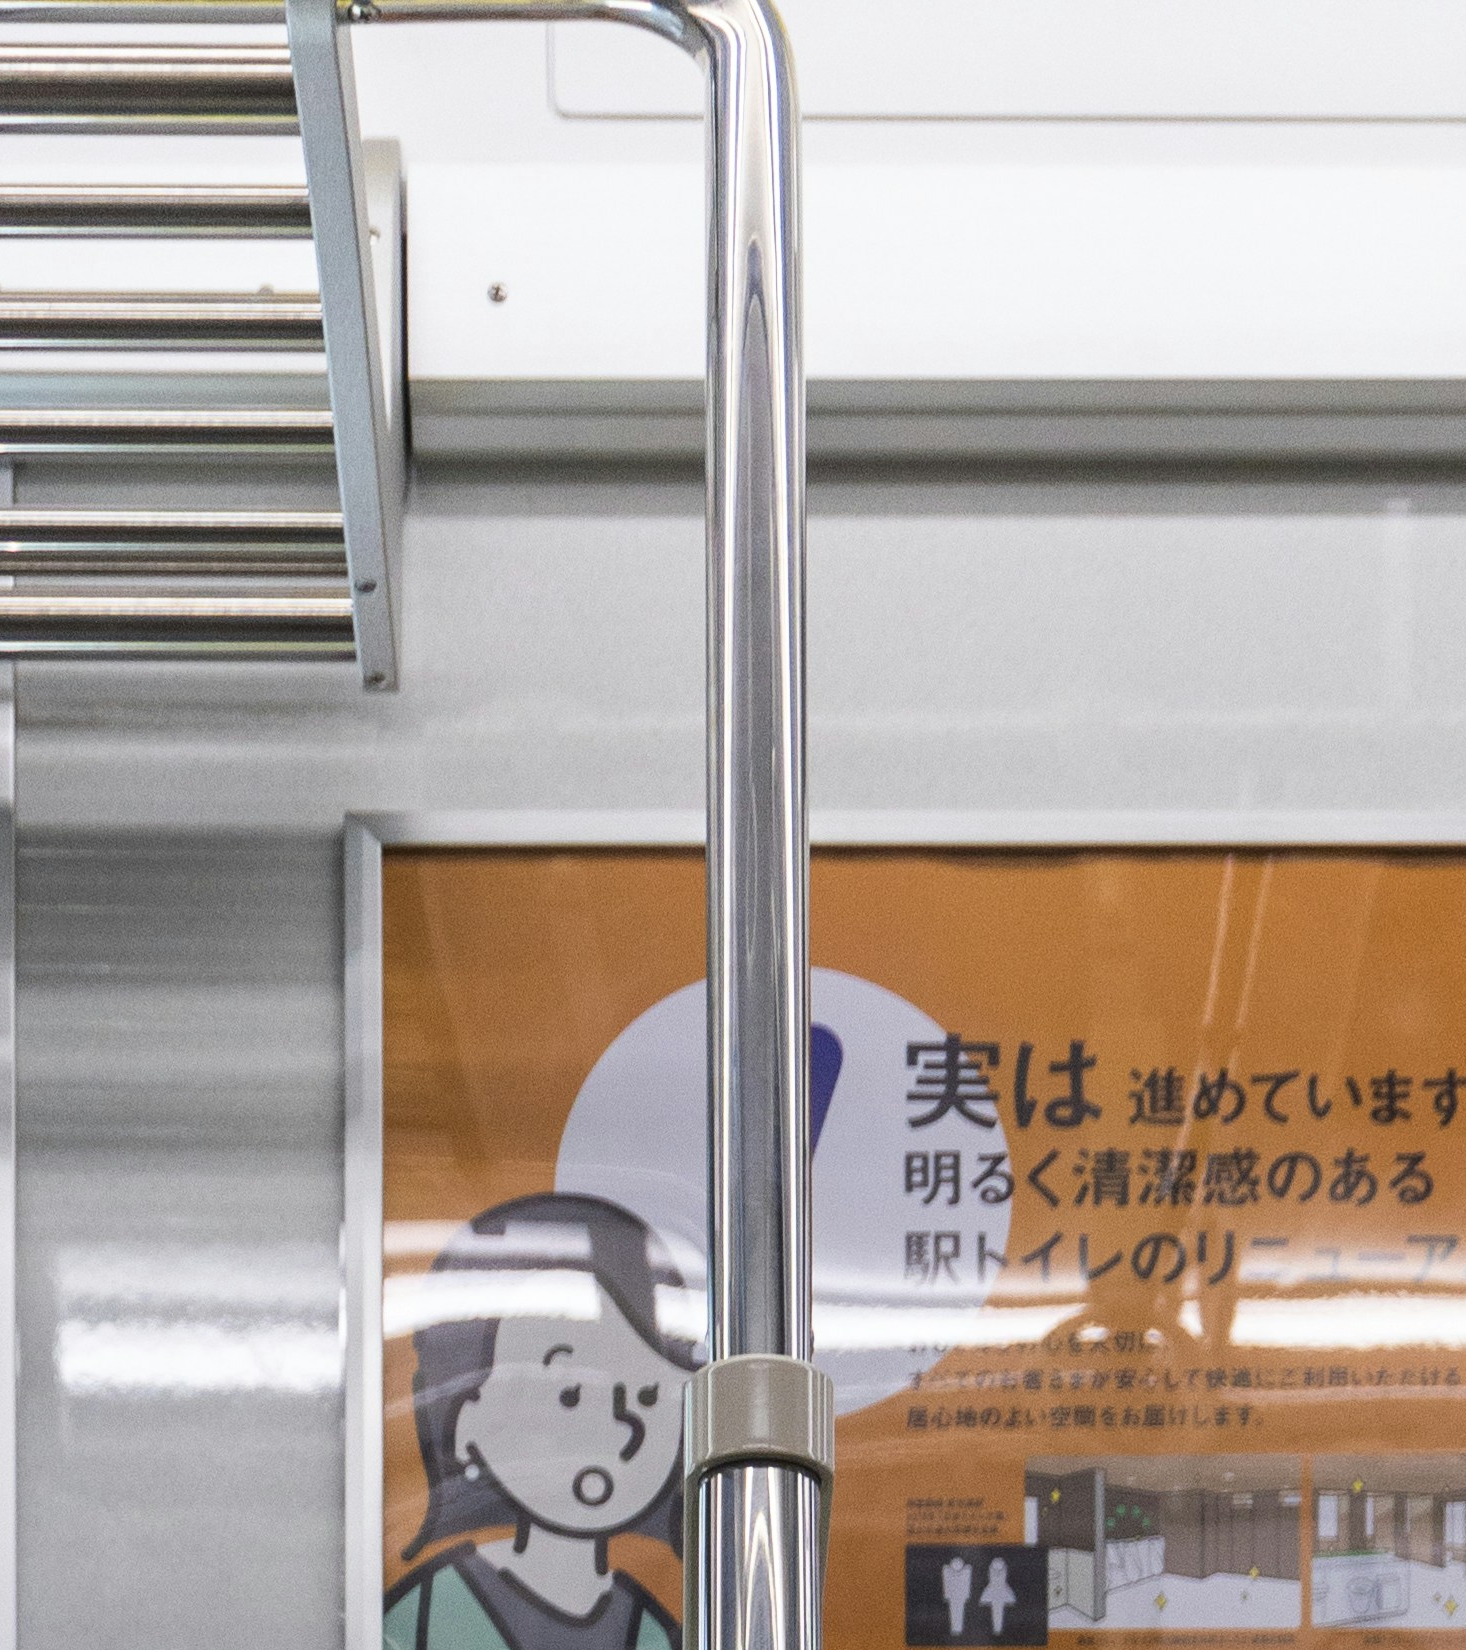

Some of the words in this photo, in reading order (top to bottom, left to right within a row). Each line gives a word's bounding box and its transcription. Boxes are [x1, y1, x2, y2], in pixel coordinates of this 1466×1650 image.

[904, 1031, 1103, 1130] 実は
[904, 1146, 1435, 1208] 明るく清潔感のある
